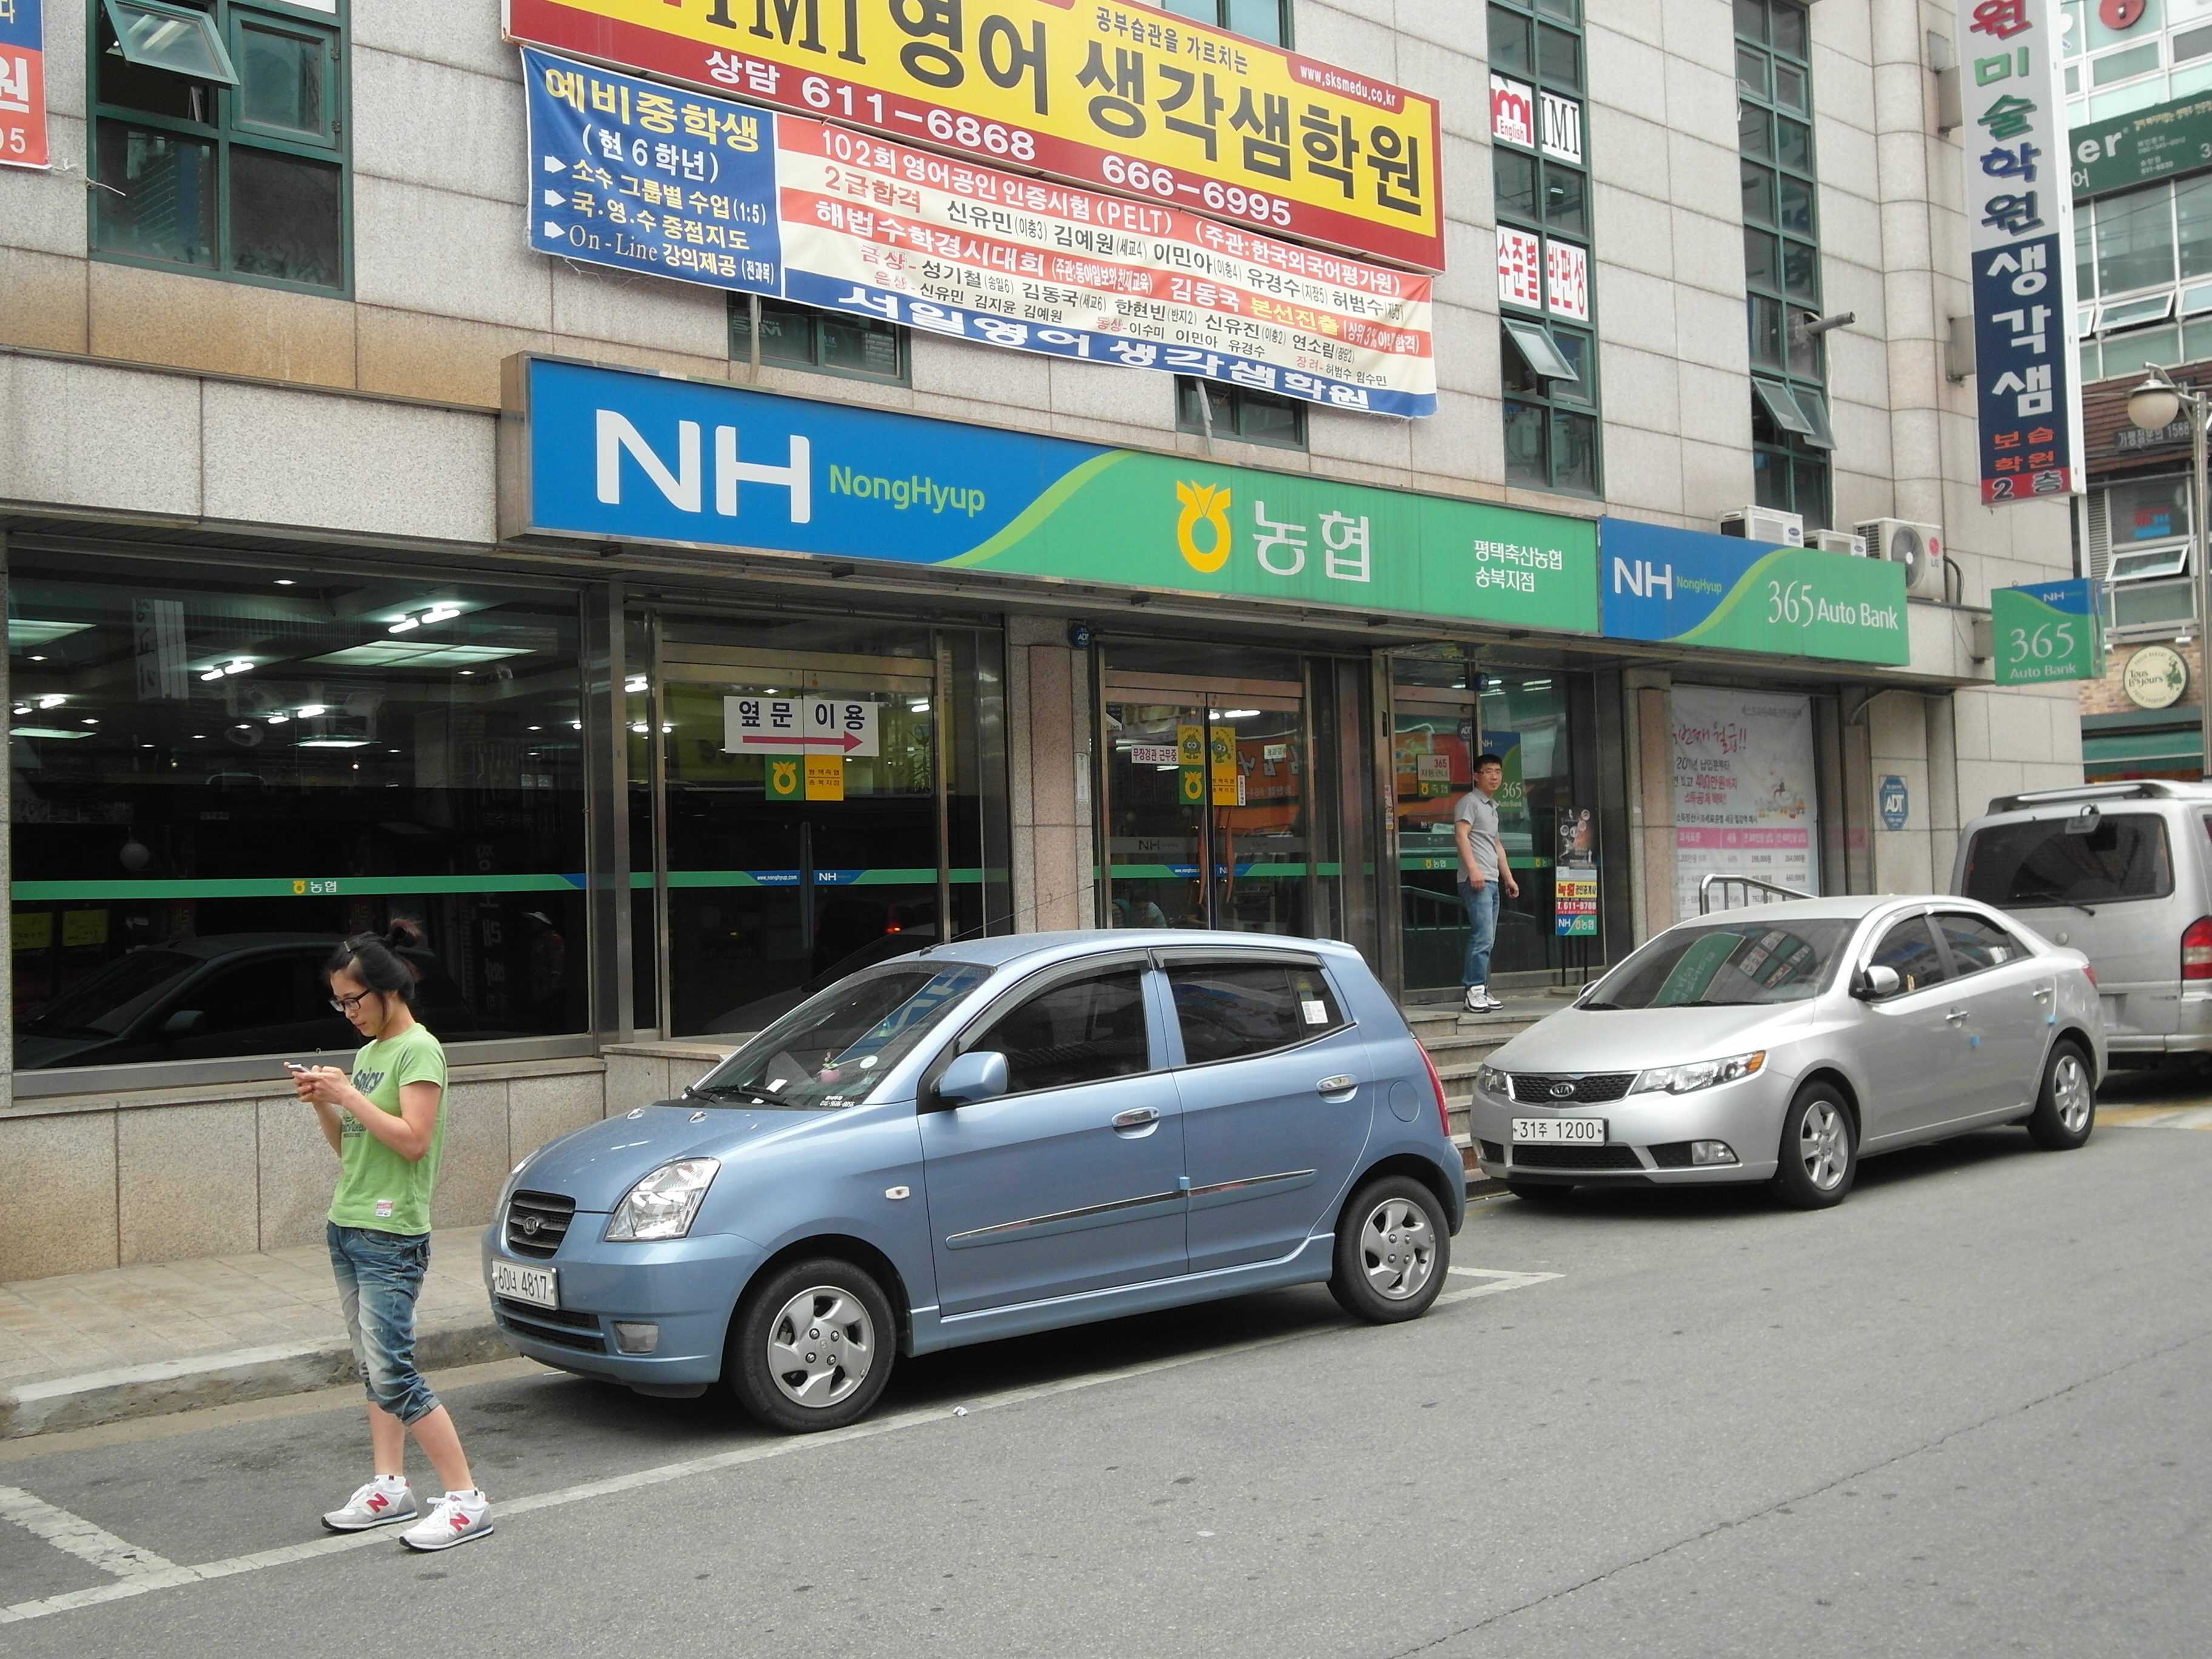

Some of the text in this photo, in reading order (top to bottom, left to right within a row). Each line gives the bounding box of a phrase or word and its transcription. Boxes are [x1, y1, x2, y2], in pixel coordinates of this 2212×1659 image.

[1096, 6, 1248, 75] 공부습관을 가르치는
[1300, 65, 1396, 107] www.sksmedu.co.kr
[545, 69, 759, 152] 예비중학생
[706, 50, 1036, 161] 상담 611-6868
[889, 0, 1422, 216] 영어 생각샘학원
[1500, 119, 1524, 141] English
[572, 159, 614, 190] 소수
[619, 175, 683, 210] 그룹별
[1102, 153, 1292, 226] 666-6995
[823, 129, 1400, 296] 102회 영어공인 인증시험 (PELT) (주관:한국외국어평가원)
[662, 215, 749, 250] 중점지도
[662, 243, 736, 277] 강의제공
[742, 258, 774, 285] (전과목)
[1170, 278, 1240, 312] 김동국
[1251, 297, 1340, 336] 본선진출
[920, 283, 964, 304] 신유민
[974, 293, 1016, 315] 김지윤
[1024, 304, 1062, 323] 김예원
[1129, 322, 1165, 340] 이수미
[1176, 330, 1218, 350] 이민아
[1228, 339, 1265, 358] 유경수
[1326, 364, 1352, 381] 허범수
[1356, 370, 1387, 387] 임수민
[1986, 244, 2053, 418] 생각샘
[1110, 340, 1369, 409] 생각샘학원
[1994, 426, 2055, 450] 보습
[596, 409, 986, 524] NH NongHyup
[1994, 451, 2055, 472] 학원
[1253, 500, 1371, 583] 농협
[1473, 539, 1563, 571] 평택축산농협
[1475, 566, 1535, 593] 송북지점
[1614, 557, 1899, 630] NH NongHyup 365 Auto Bank
[2043, 591, 2065, 602] NH
[2009, 622, 2074, 663] 365
[2009, 663, 2077, 679] Auto Bank
[1133, 748, 1177, 762] 무장경관 근무중
[1434, 759, 1447, 768] 365
[1421, 769, 1448, 778] 자동코너
[1503, 782, 1523, 799] 365
[1885, 794, 1904, 813] ADT
[310, 880, 337, 893] 농협
[819, 873, 837, 881] NH
[1558, 918, 1571, 927] NH
[1554, 1085, 1570, 1094] KIA
[1520, 1121, 1595, 1139] 31주 1200
[521, 1271, 546, 1300] 4817
